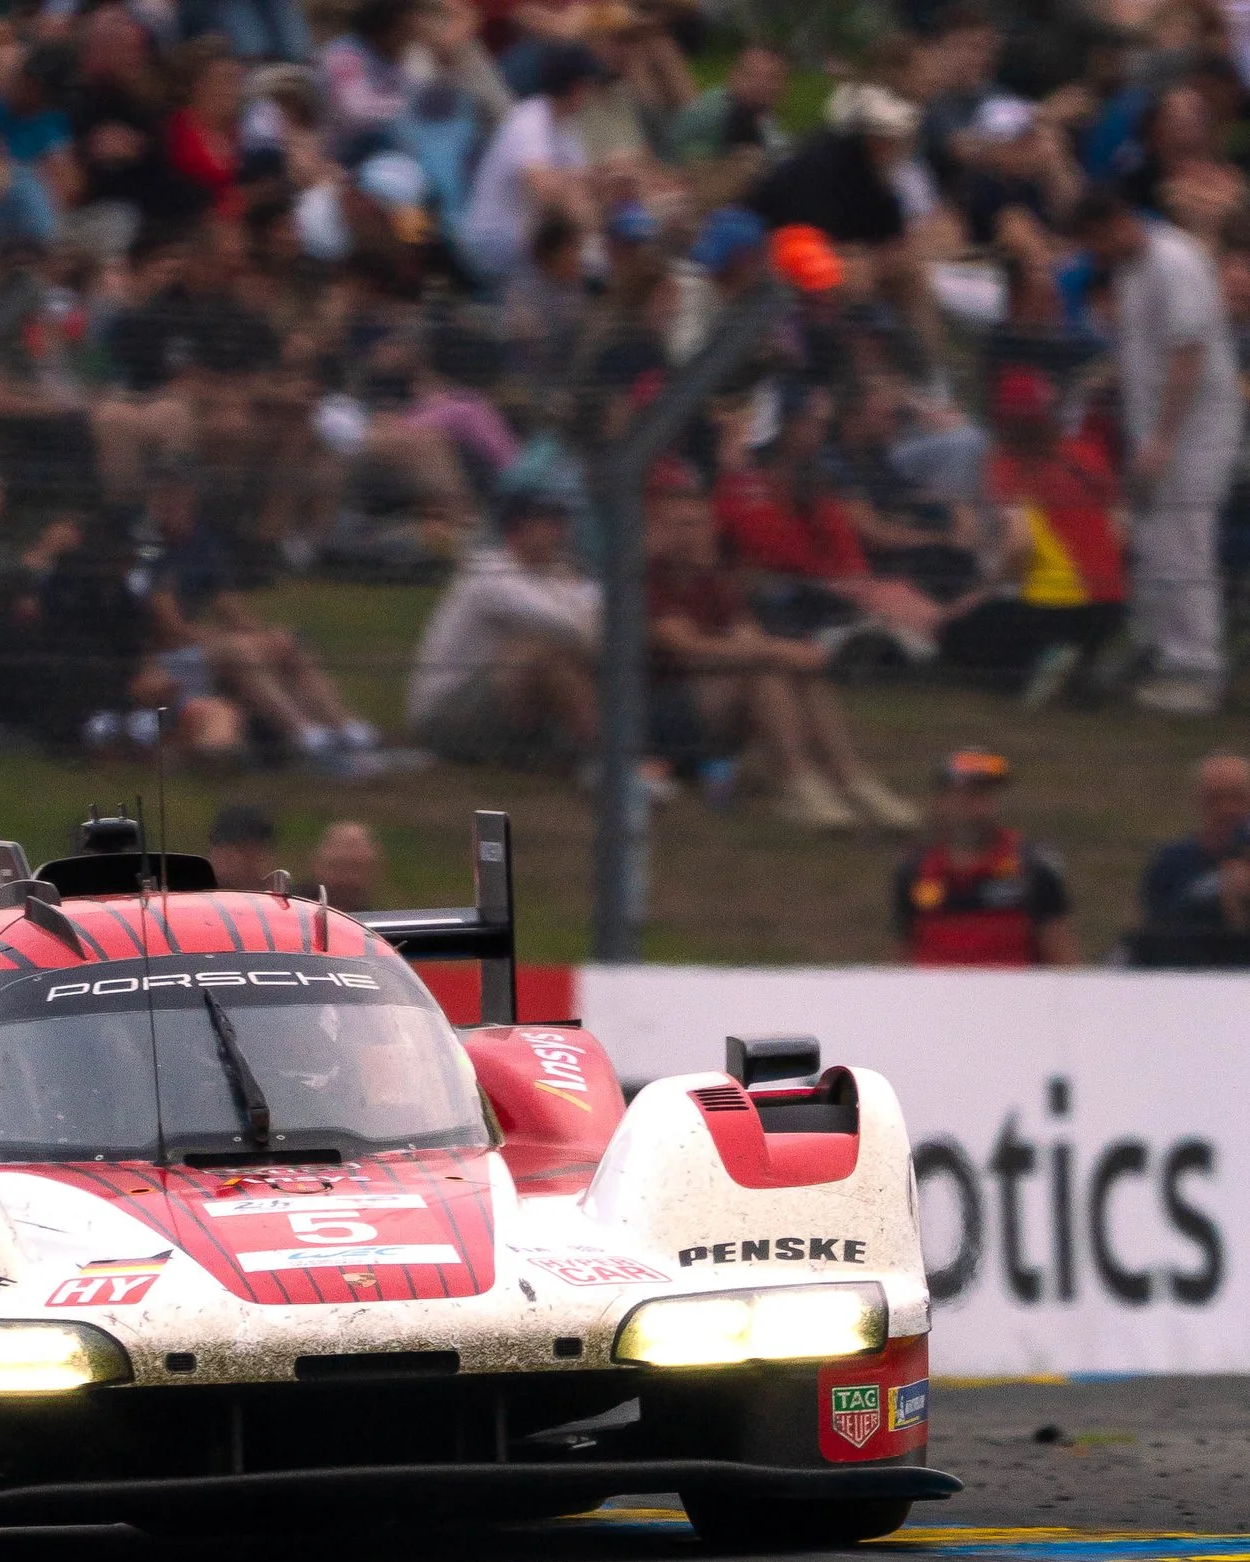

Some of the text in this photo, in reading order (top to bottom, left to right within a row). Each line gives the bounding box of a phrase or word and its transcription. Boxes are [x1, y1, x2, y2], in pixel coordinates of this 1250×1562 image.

[47, 971, 381, 1002] PORSCHE
[519, 1030, 593, 1114] Ansys
[910, 1073, 1225, 1308] otics
[287, 1211, 378, 1244] 5
[679, 1237, 867, 1268] PENSKE
[559, 1266, 660, 1282] CAR
[50, 1276, 146, 1305] HY
[837, 1389, 876, 1409] TAG
[836, 1412, 878, 1441] HEUER
